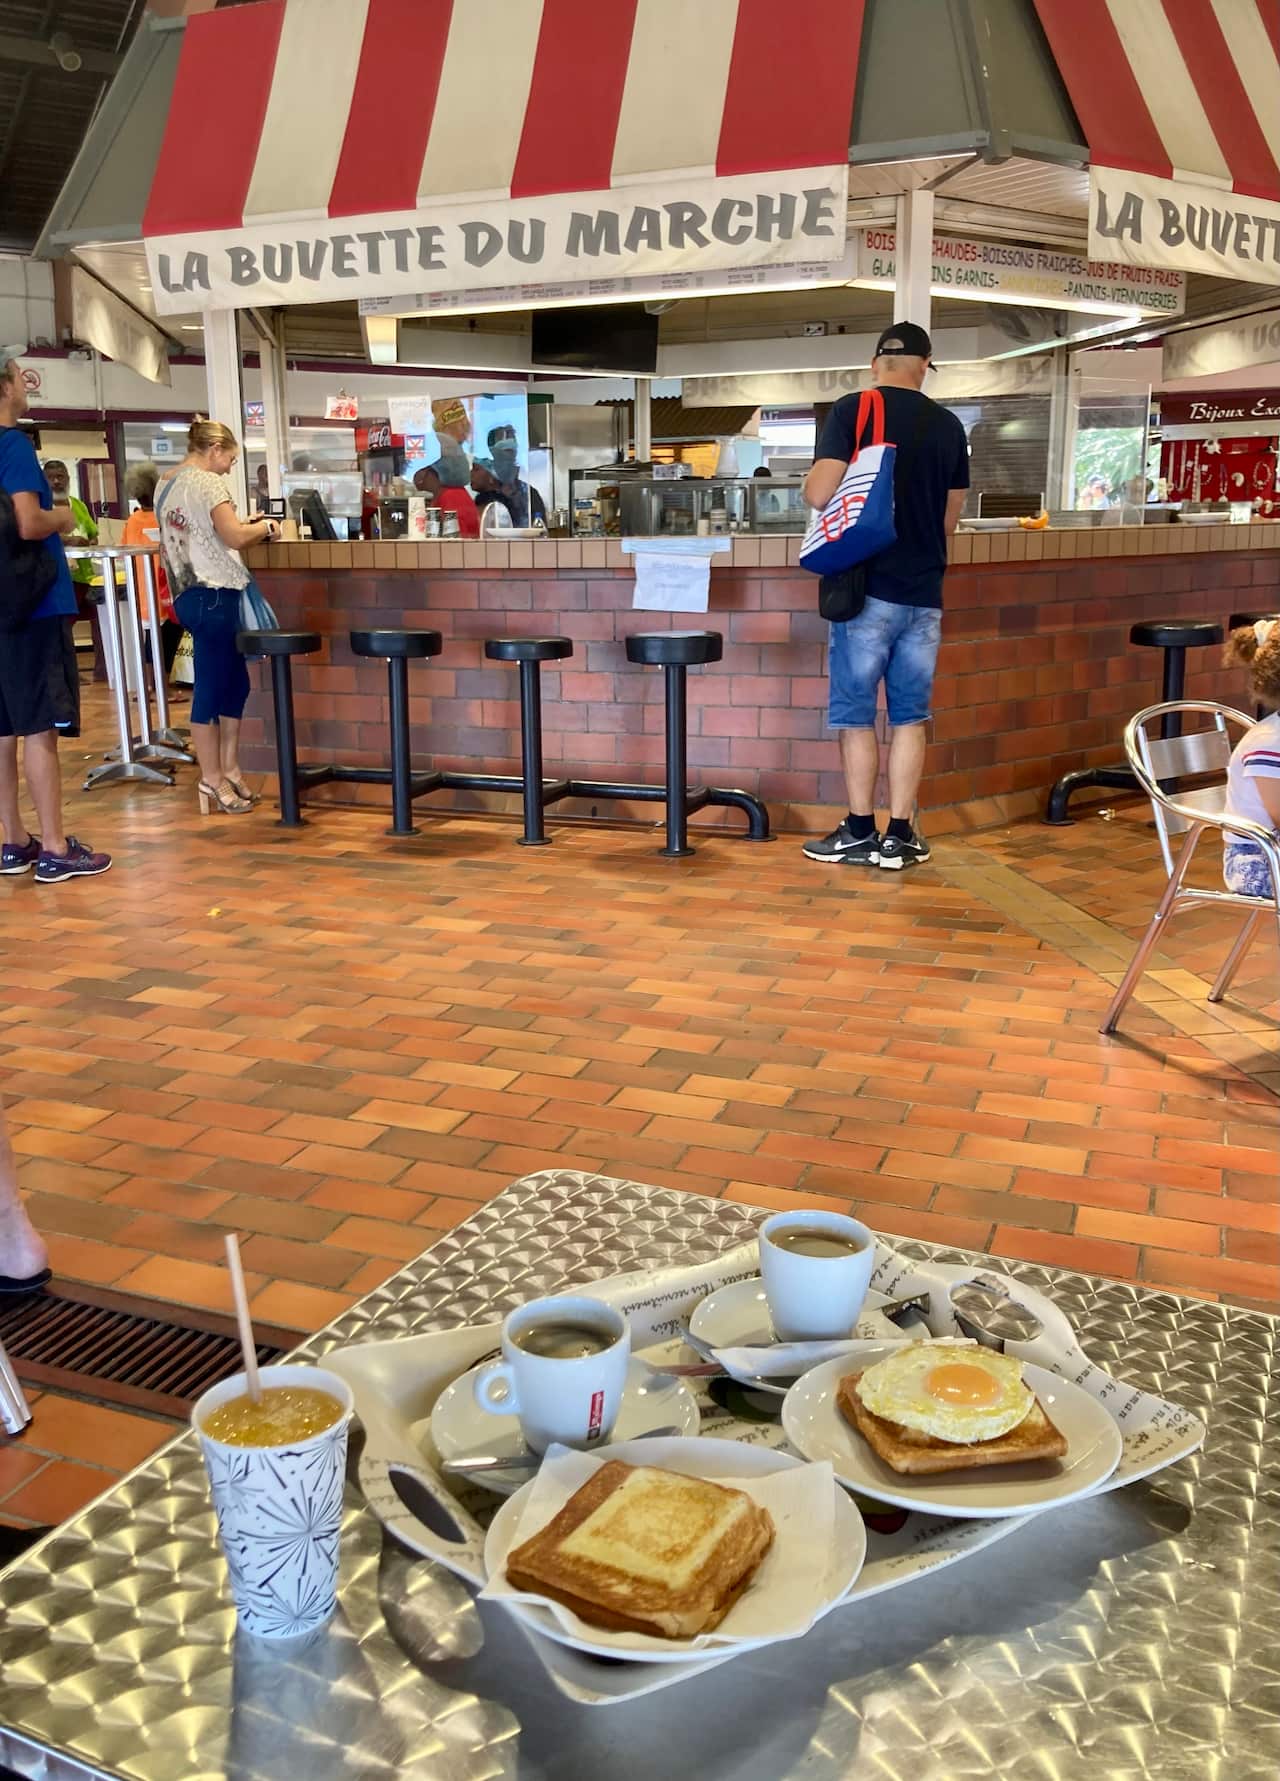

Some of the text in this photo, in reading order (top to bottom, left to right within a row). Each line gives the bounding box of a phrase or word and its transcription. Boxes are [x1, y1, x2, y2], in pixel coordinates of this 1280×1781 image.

[1096, 189, 1144, 245] LA
[158, 187, 835, 293] LA BUVETTE DU MARCHE
[866, 231, 896, 251] BOIS
[1107, 263, 1119, 280] DE
[1121, 265, 1152, 284] FRUITS
[872, 259, 896, 277] GLA
[931, 265, 952, 284] INS
[1189, 402, 1245, 422] Bijoux
[621, 1288, 690, 1316] recruitment
[692, 1281, 714, 1298] This
